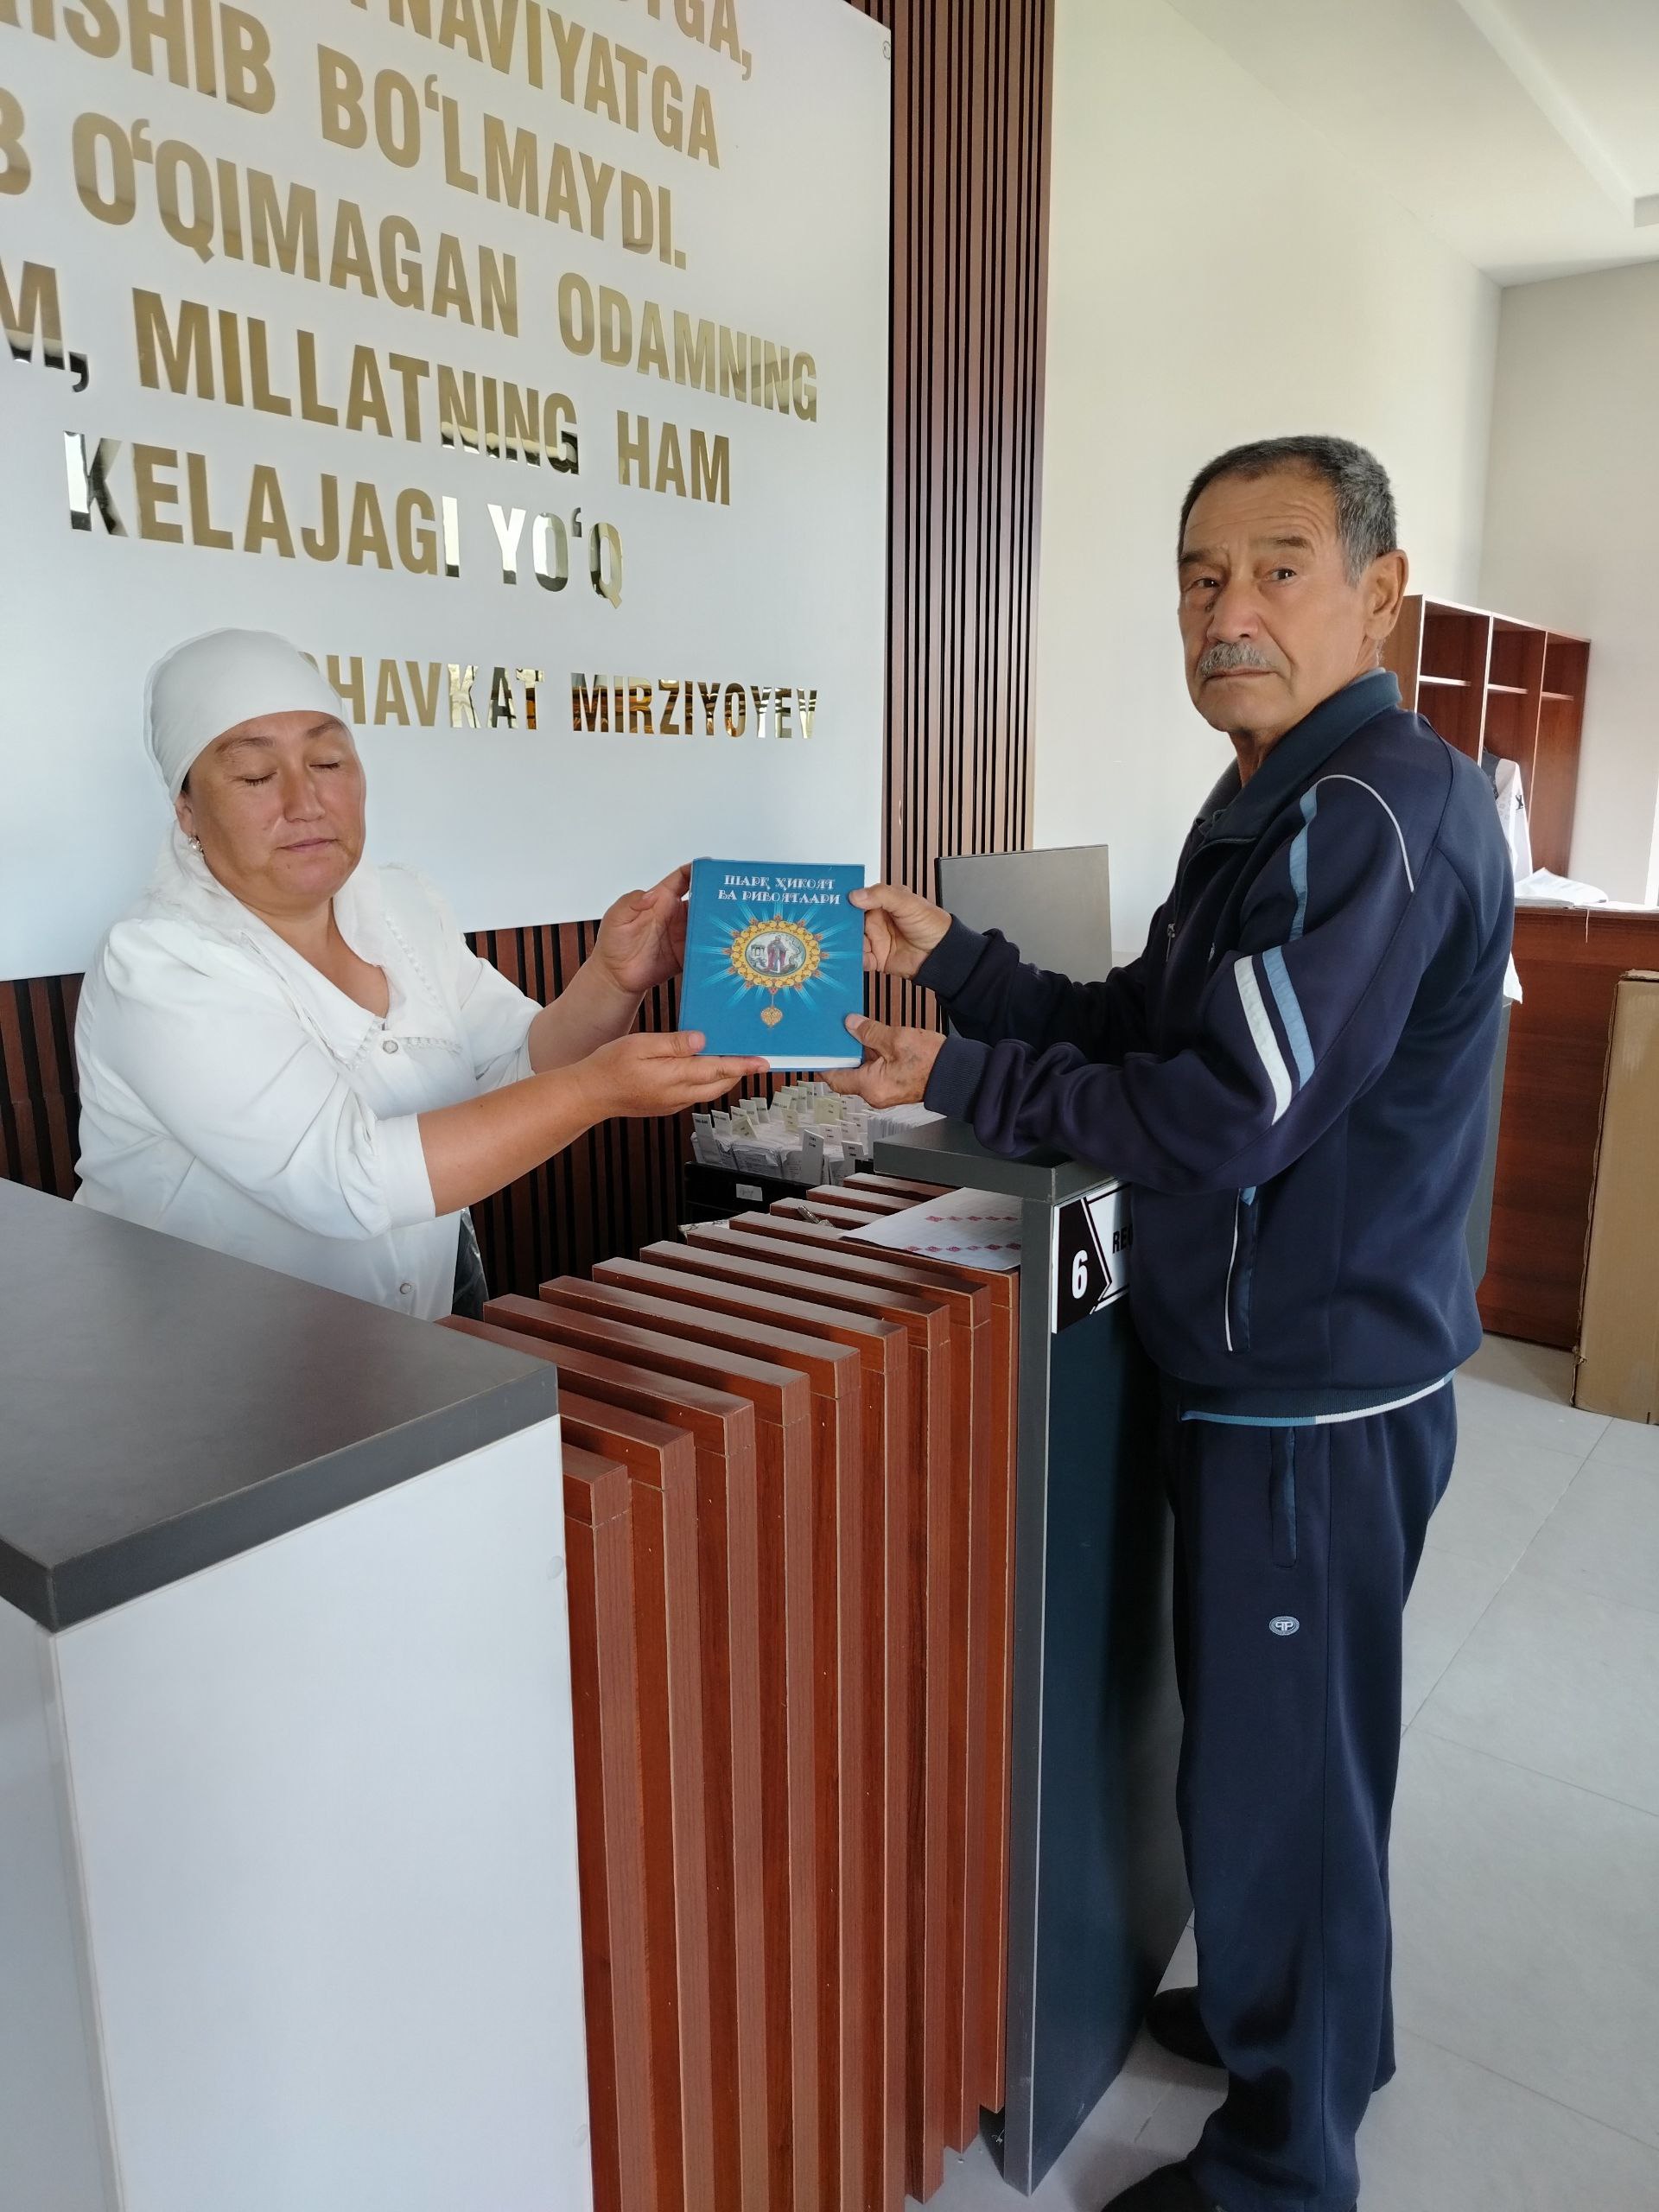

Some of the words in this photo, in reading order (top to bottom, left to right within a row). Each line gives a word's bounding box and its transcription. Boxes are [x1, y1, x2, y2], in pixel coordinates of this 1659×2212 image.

[317, 42, 687, 270] BO‘LMAYDI.
[72, 111, 519, 339] O‘QIMAGAN
[557, 272, 818, 423] ODAMNING
[132, 287, 580, 476] MILLATNING
[616, 410, 731, 506] HAM
[63, 429, 461, 578] KELAJAGI
[486, 503, 623, 609] YO‘Q
[296, 652, 545, 731] HAVKAT
[570, 672, 818, 740] MIRZIYOYEV
[717, 889, 738, 900] ВА
[741, 890, 841, 905] РИВОЯТЛАРИ
[723, 874, 771, 890] ШАРҚ
[774, 877, 836, 891] ҲИКОЯТ
[1071, 1249, 1089, 1300] 6
